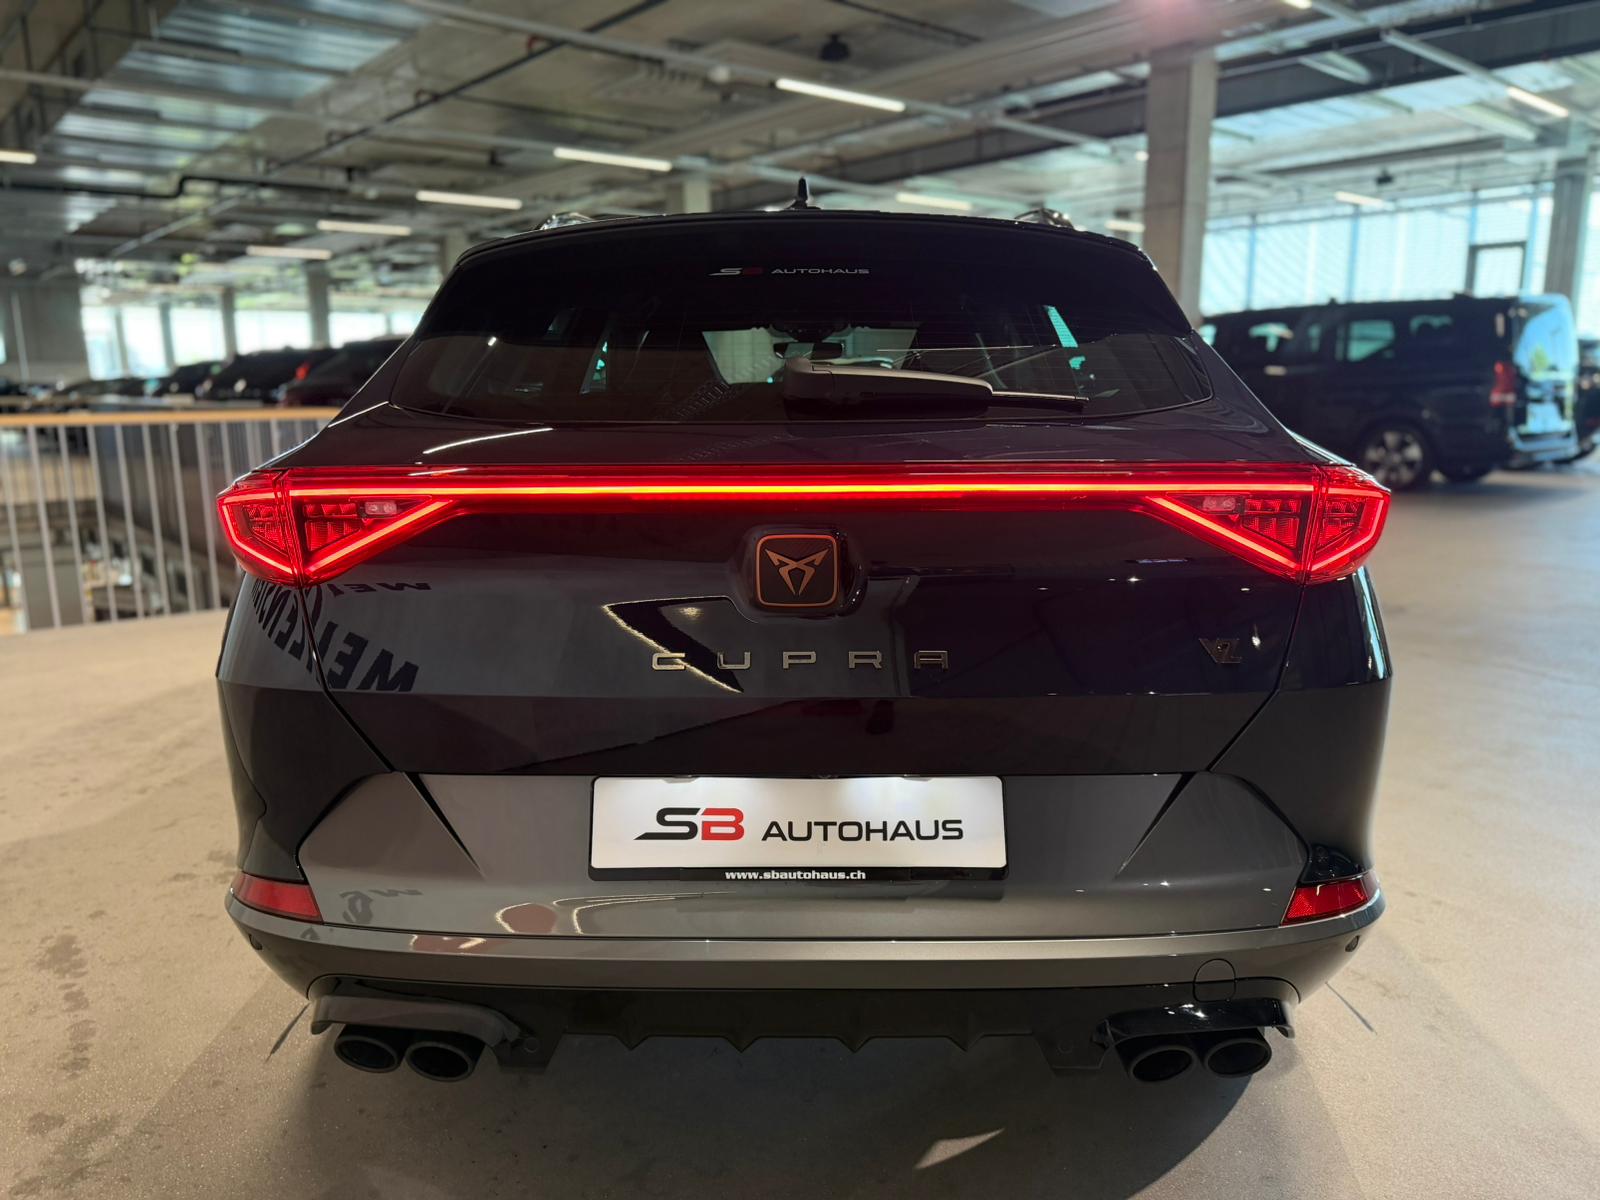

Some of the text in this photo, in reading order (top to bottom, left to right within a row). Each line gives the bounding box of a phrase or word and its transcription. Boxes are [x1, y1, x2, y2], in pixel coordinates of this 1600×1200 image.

[651, 650, 949, 670] CUPRA
[633, 807, 964, 841] SB AUTOHAUS
[724, 870, 866, 880] www.sbautohaus.ch
